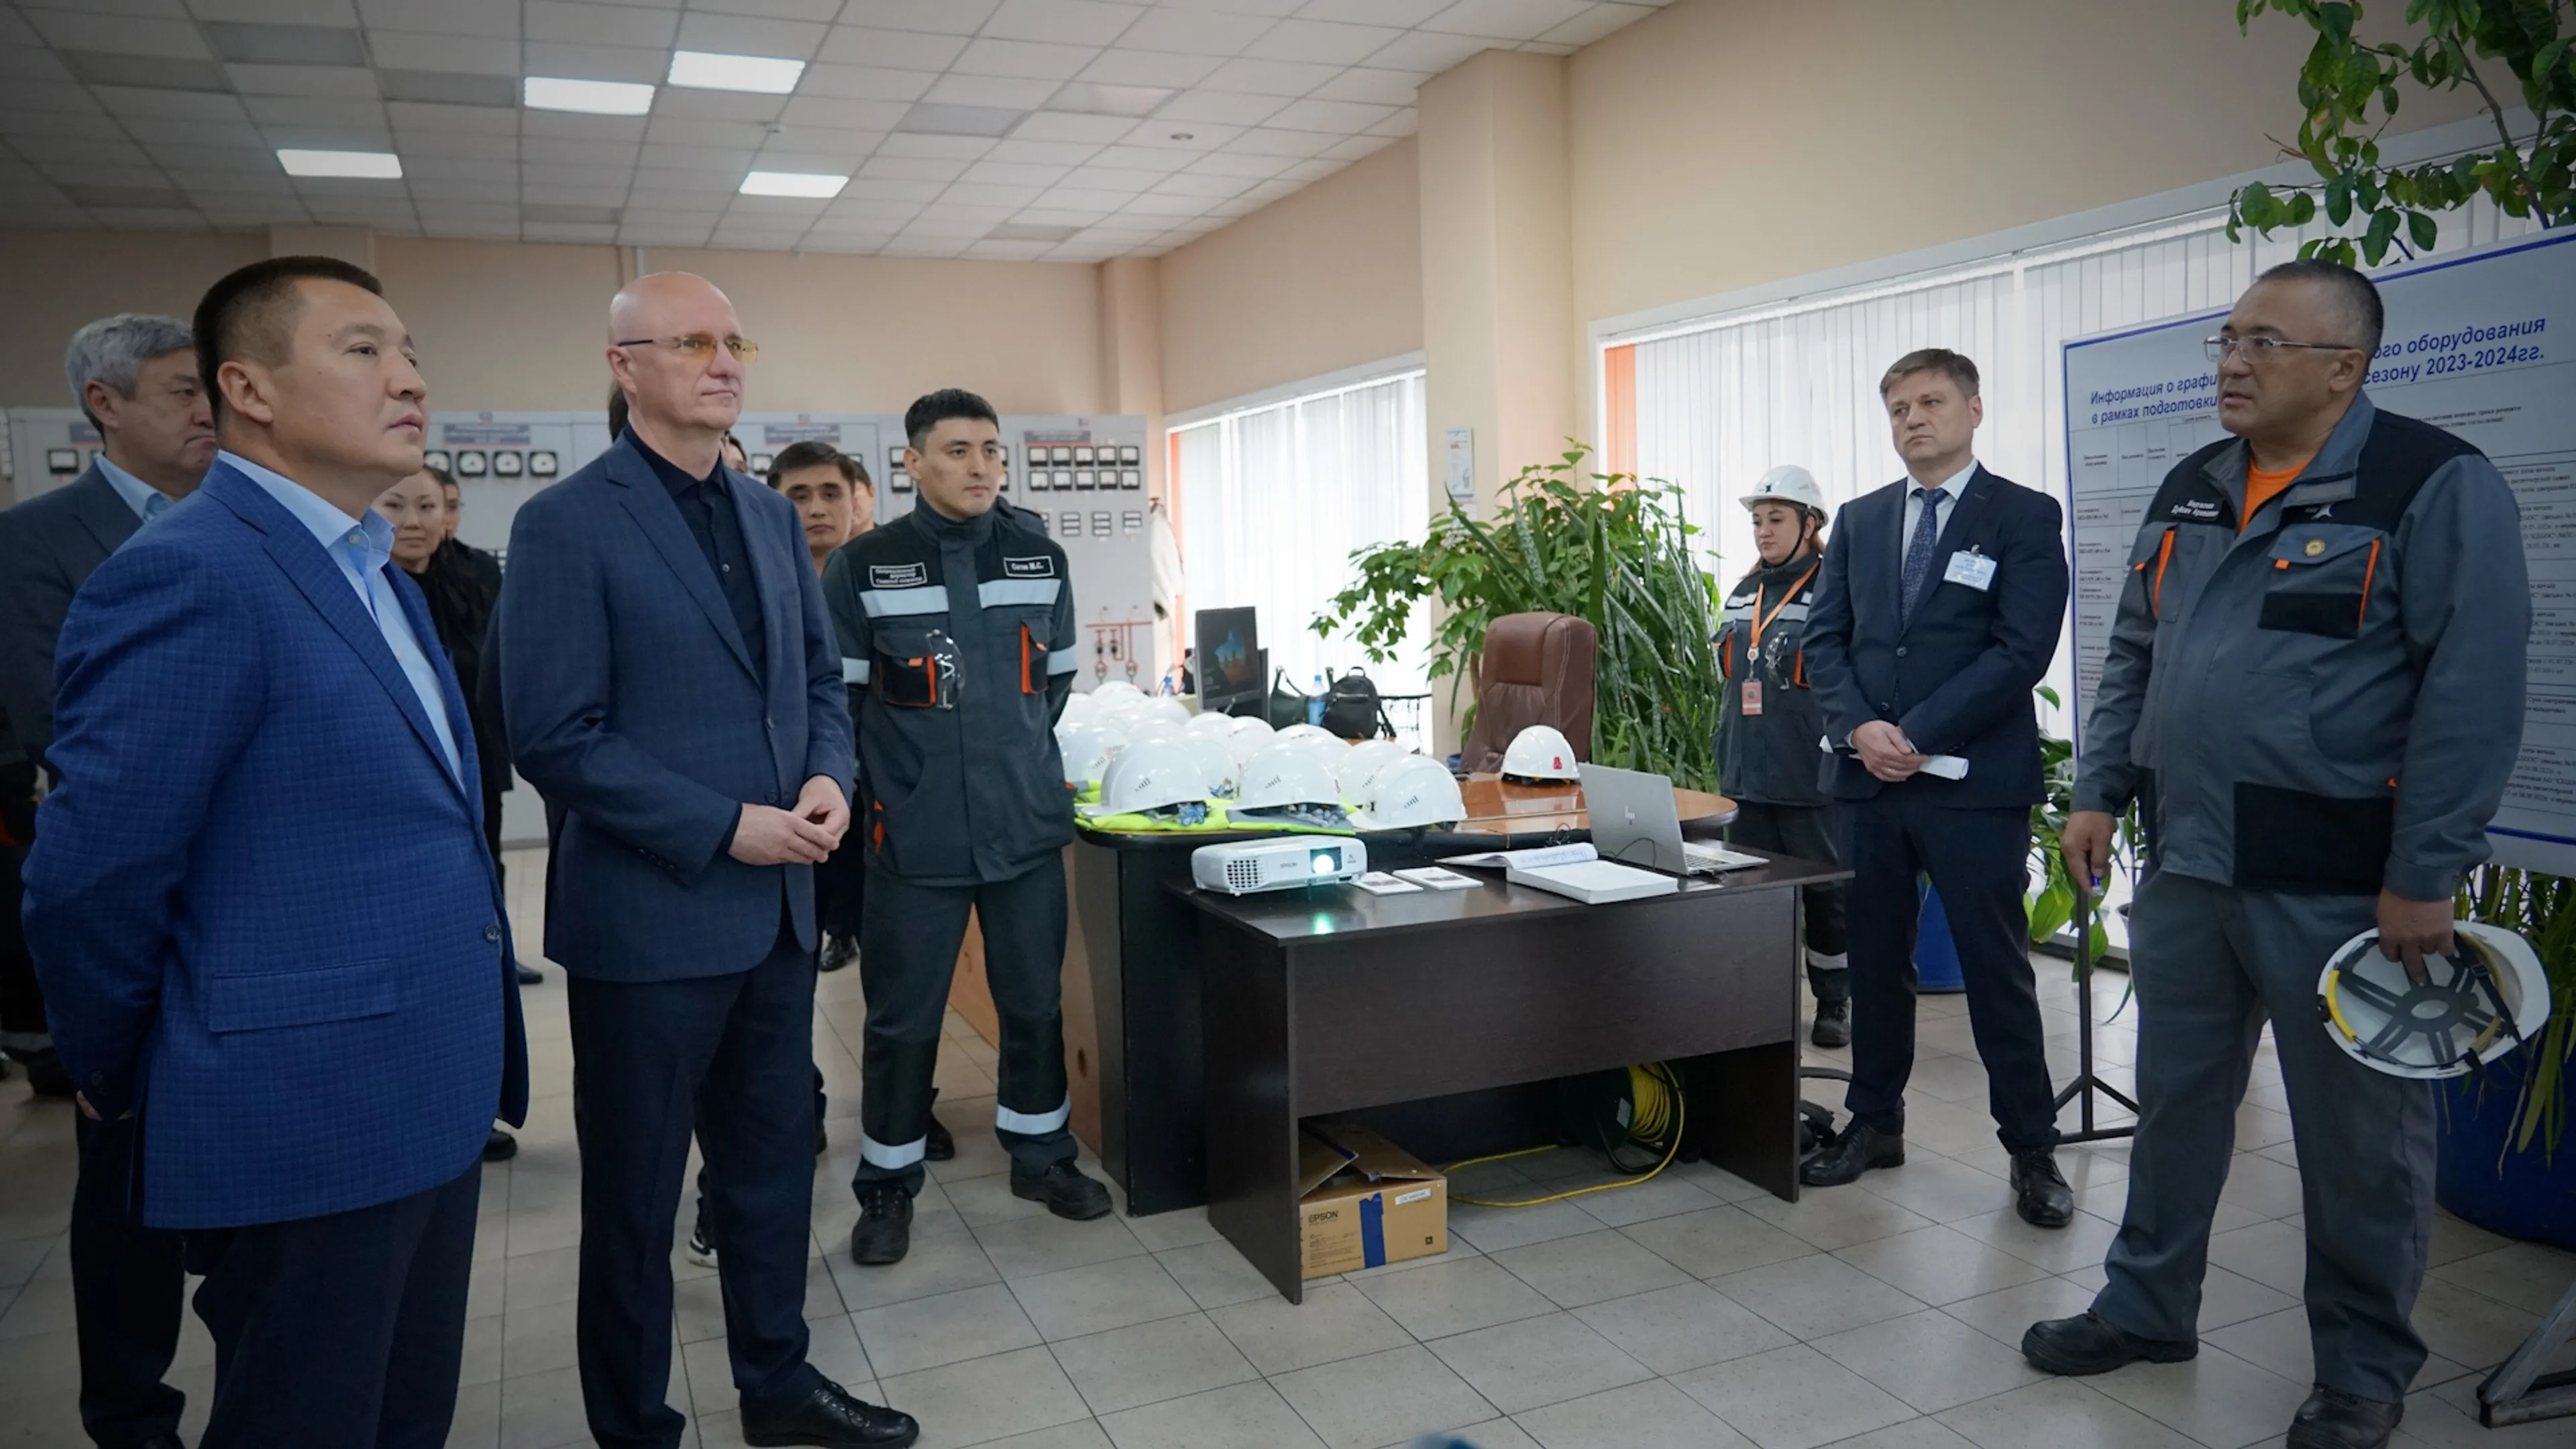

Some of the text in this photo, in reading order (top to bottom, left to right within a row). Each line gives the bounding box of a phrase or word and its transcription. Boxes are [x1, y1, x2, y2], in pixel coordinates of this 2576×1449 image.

[2090, 318, 2546, 405] Информация о графи ого оборудования
[2092, 345, 2544, 425] в рамках подготовки сезону 2023-2024гг.
[1309, 1210, 1338, 1224] EPSON
